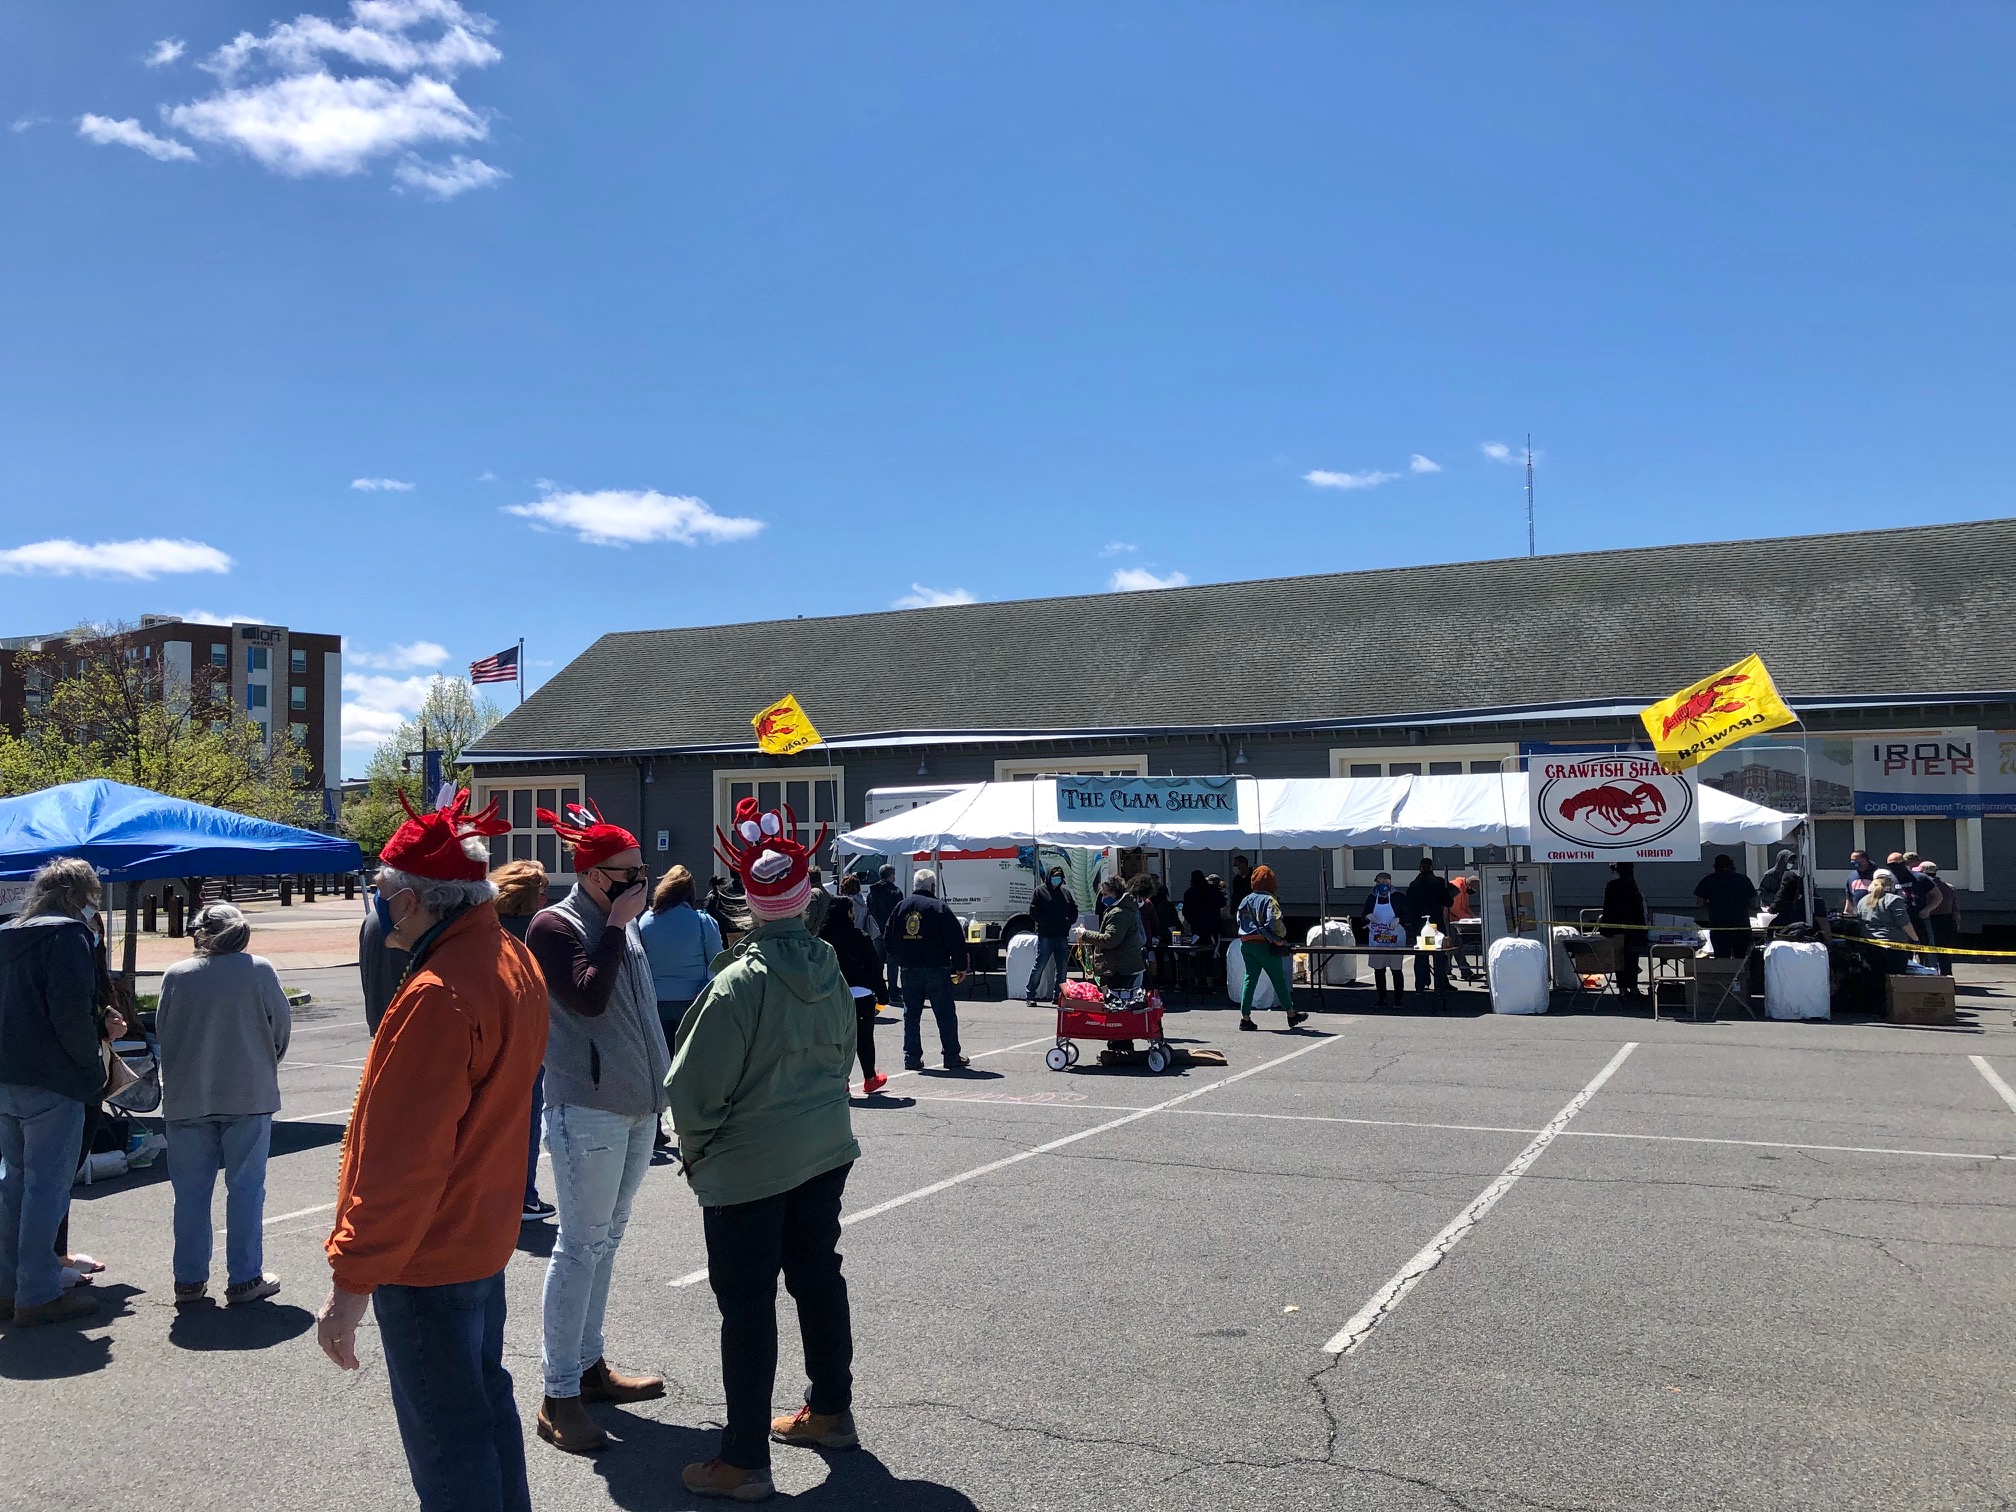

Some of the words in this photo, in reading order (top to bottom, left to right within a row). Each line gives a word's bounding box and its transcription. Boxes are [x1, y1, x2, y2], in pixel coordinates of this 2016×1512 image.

[1874, 743, 1971, 761] IRON
[1545, 763, 1624, 778] CRAWFISH
[1629, 761, 1684, 778] SHACK
[1884, 758, 1975, 776] PIER
[1061, 789, 1106, 810] THE
[1110, 790, 1162, 812] CLAM
[1166, 790, 1234, 812] SHACK
[1865, 804, 1888, 812] COR
[1891, 803, 1952, 812] Development
[1547, 851, 1594, 859] CRAWFISH
[1636, 849, 1673, 858] SHRIMP
